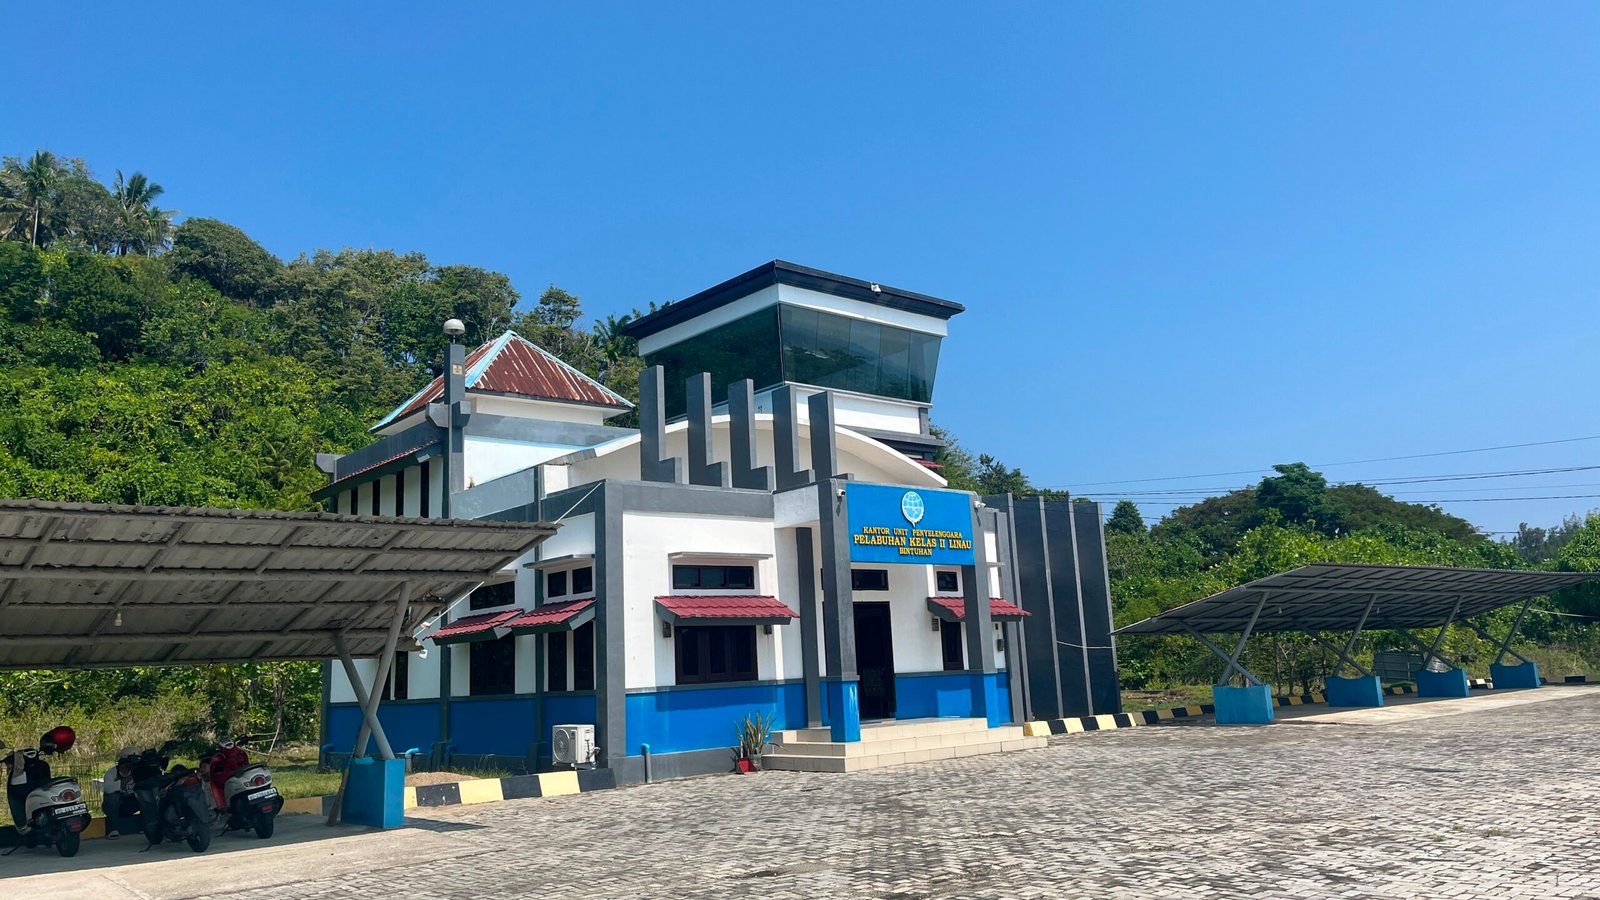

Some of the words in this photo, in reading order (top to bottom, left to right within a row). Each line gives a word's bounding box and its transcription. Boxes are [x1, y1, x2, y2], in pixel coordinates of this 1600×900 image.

[863, 526, 890, 535] KANTOR
[893, 528, 908, 536] UNIT
[912, 529, 963, 539] PENYELENGGARA
[853, 534, 906, 546] PELABUHAN
[909, 537, 937, 548] KELAS
[939, 538, 946, 548] II
[949, 540, 972, 550] LINAU
[899, 547, 933, 556] BINTUHAN
